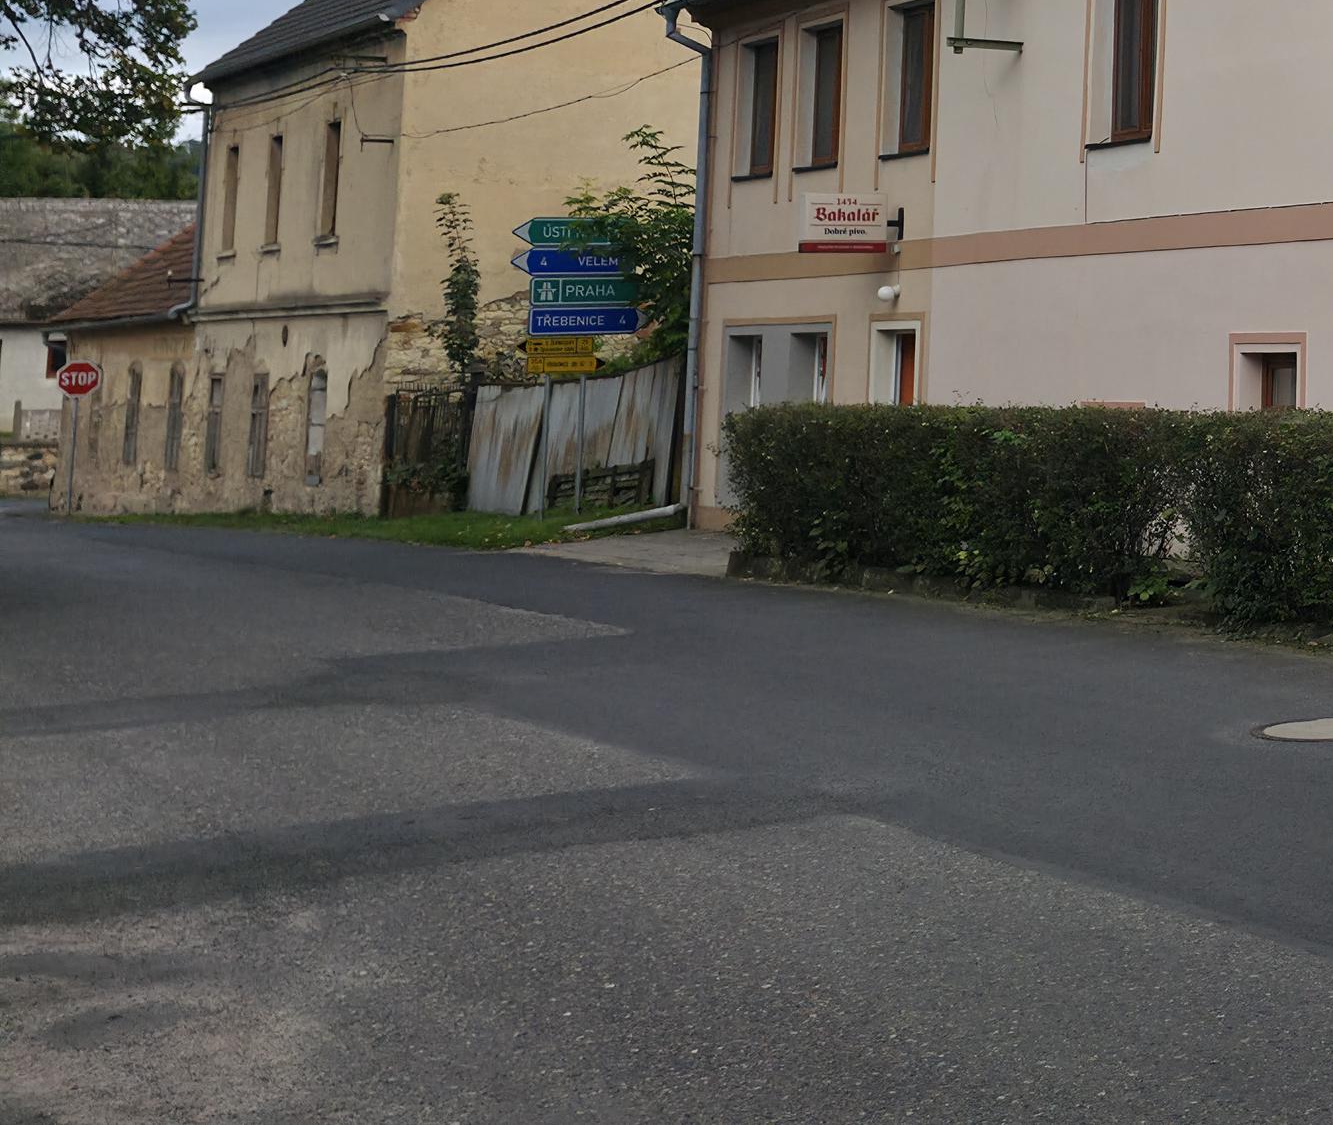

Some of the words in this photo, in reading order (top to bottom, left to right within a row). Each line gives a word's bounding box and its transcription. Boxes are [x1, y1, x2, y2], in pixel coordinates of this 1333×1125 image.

[815, 207, 879, 222] Bakalář
[824, 227, 847, 236] Dobré
[849, 227, 867, 236] pivo.
[540, 256, 547, 267] 4
[565, 285, 616, 297] PRAHA
[536, 314, 605, 327] TŘEBENICE
[619, 315, 626, 325] 4
[61, 371, 97, 387] STOP
